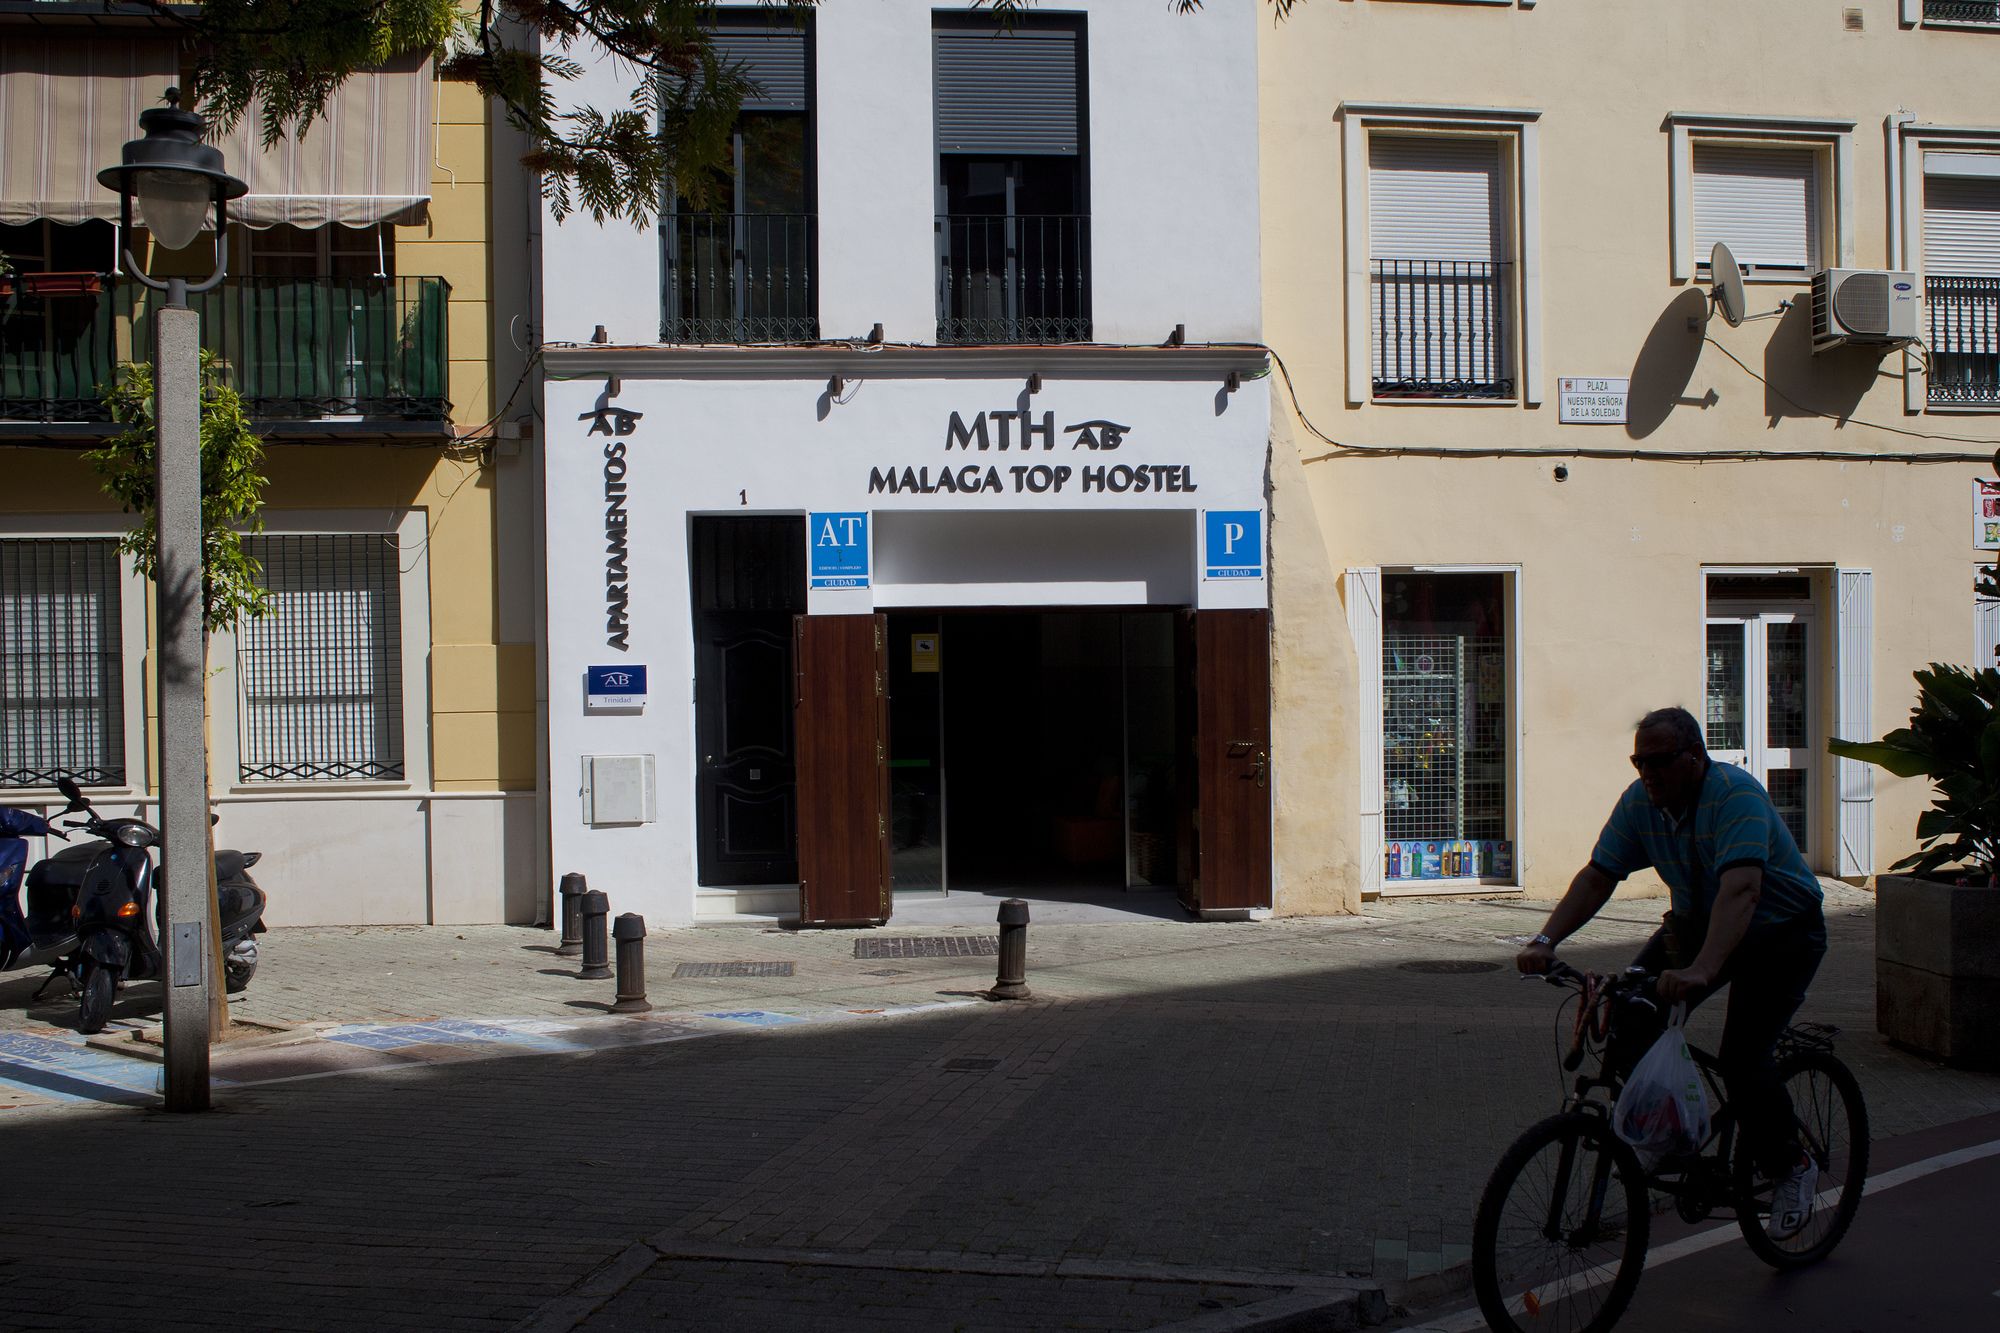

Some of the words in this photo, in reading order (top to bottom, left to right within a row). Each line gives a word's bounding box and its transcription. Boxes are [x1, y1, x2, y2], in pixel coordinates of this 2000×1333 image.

[1587, 381, 1608, 391] PLAZA
[1567, 397, 1596, 406] NUESTRA
[1597, 396, 1623, 406] SEÑORA
[1571, 408, 1579, 417] DE
[1581, 408, 1590, 417] LA
[1591, 408, 1620, 417] SOLEDAD
[585, 410, 638, 437] AB
[945, 410, 1055, 451] MTH
[1069, 423, 1127, 450] AB
[868, 465, 1004, 494] MALAGA
[1009, 464, 1072, 493] TOP
[1082, 463, 1198, 493] HOSTEL
[739, 488, 748, 505] 1
[816, 517, 862, 547] AT
[1223, 523, 1244, 555] P
[604, 441, 629, 652] APARTAMENTOS
[1217, 569, 1251, 577] CIUDAD
[824, 579, 857, 587] CIUDAD
[602, 673, 631, 685] AB
